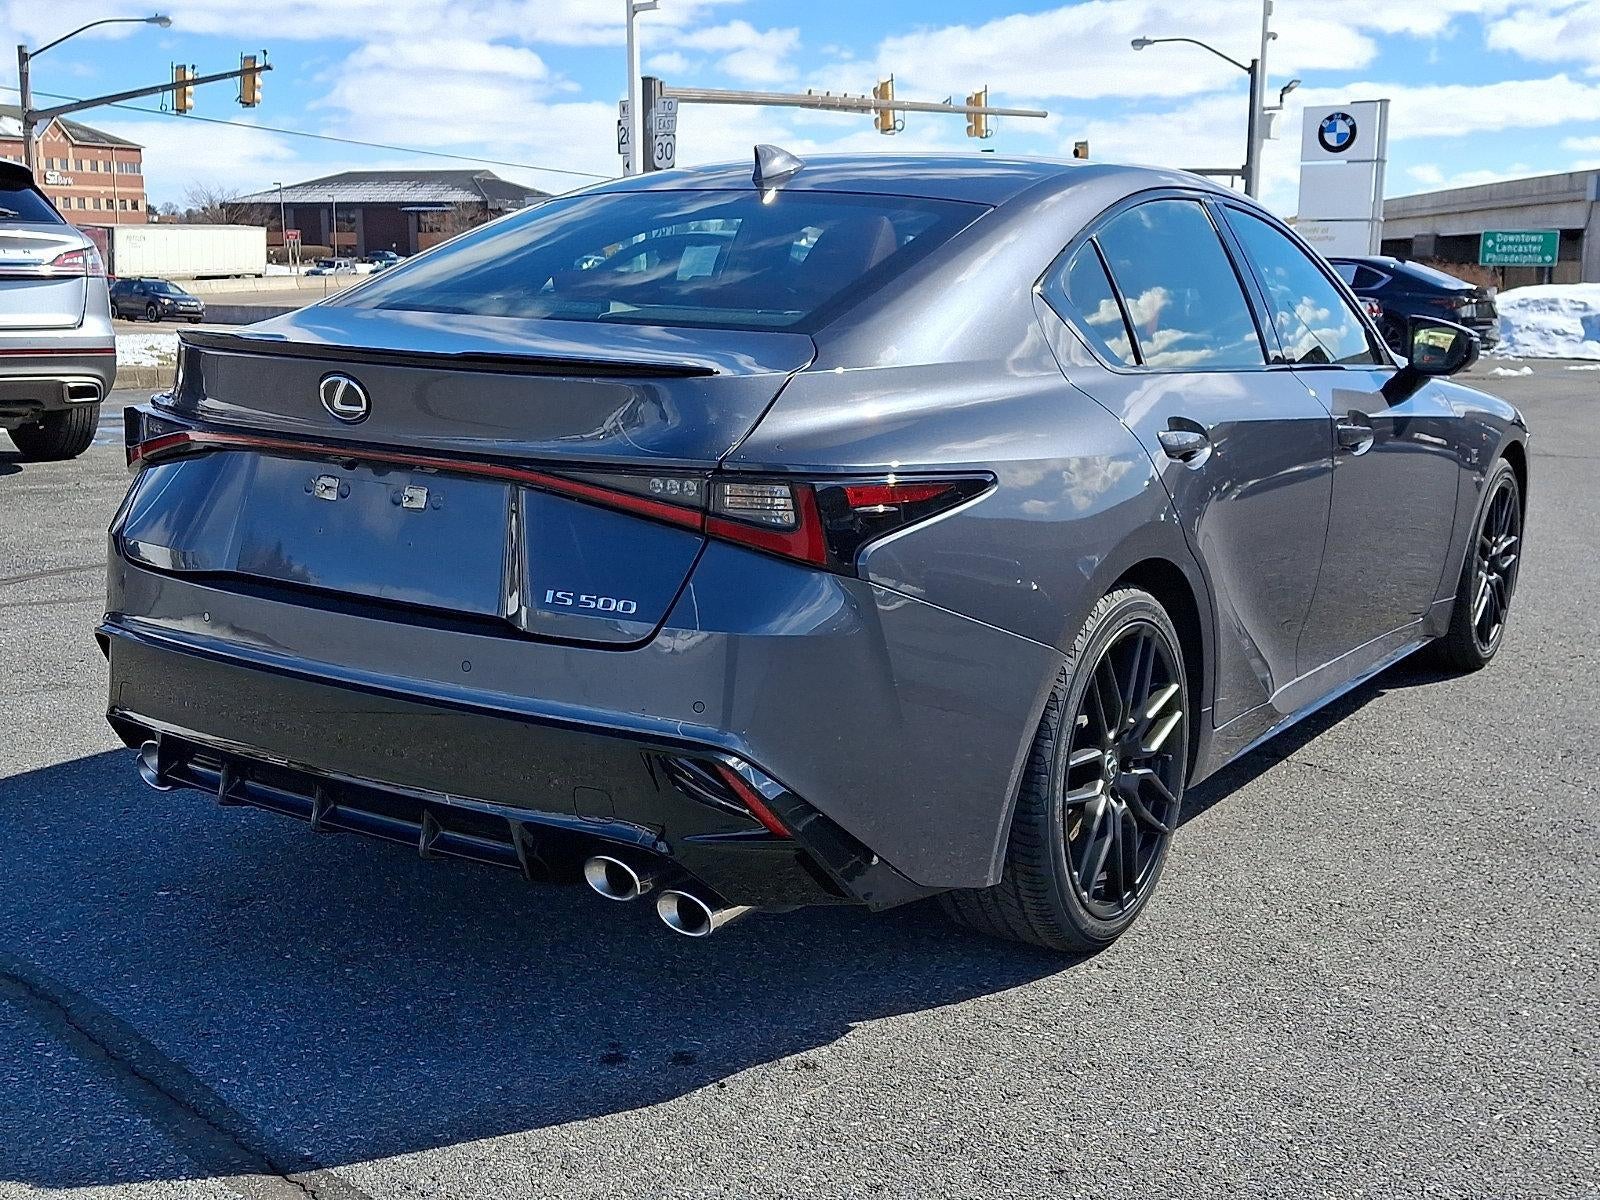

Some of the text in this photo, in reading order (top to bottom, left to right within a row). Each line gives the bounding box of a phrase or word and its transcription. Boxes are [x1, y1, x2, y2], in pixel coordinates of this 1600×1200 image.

[662, 101, 674, 111] TO
[658, 118, 674, 130] EAST
[656, 142, 673, 161] 30
[1496, 232, 1544, 243] Downtown
[1495, 243, 1542, 253] Lancaster
[1485, 253, 1542, 264] Philadelphia
[545, 589, 637, 614] IS 500
